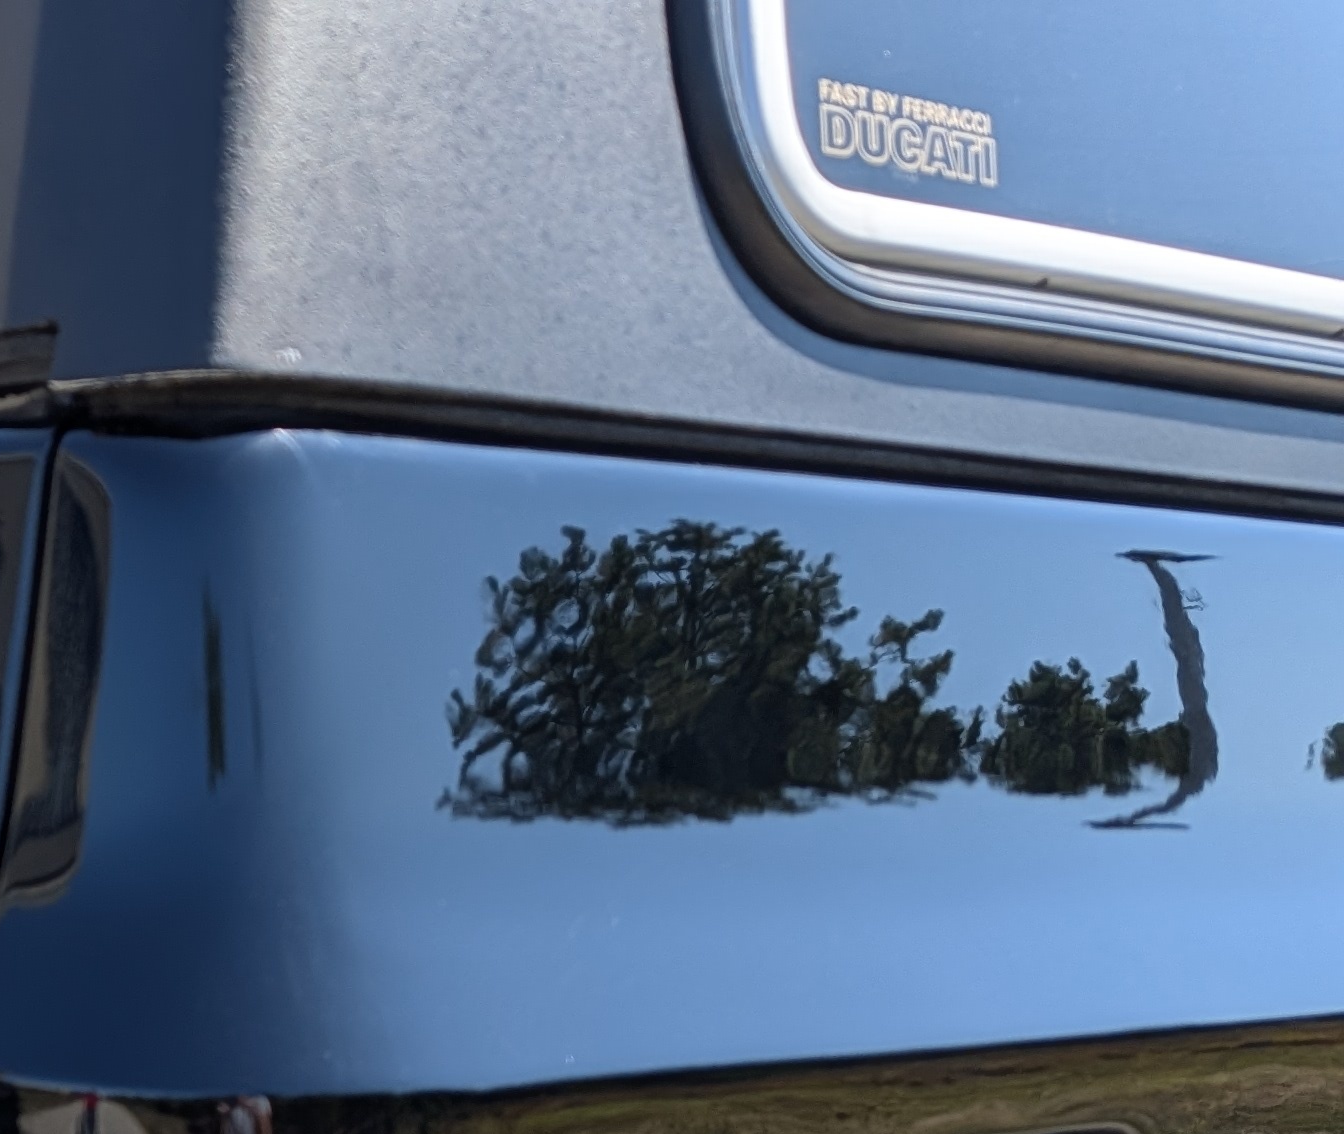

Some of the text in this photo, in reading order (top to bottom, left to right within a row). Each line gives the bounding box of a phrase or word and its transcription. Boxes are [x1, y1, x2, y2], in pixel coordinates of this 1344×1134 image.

[818, 78, 993, 135] FAST BY FERRACCI
[818, 102, 999, 188] DUCATI
